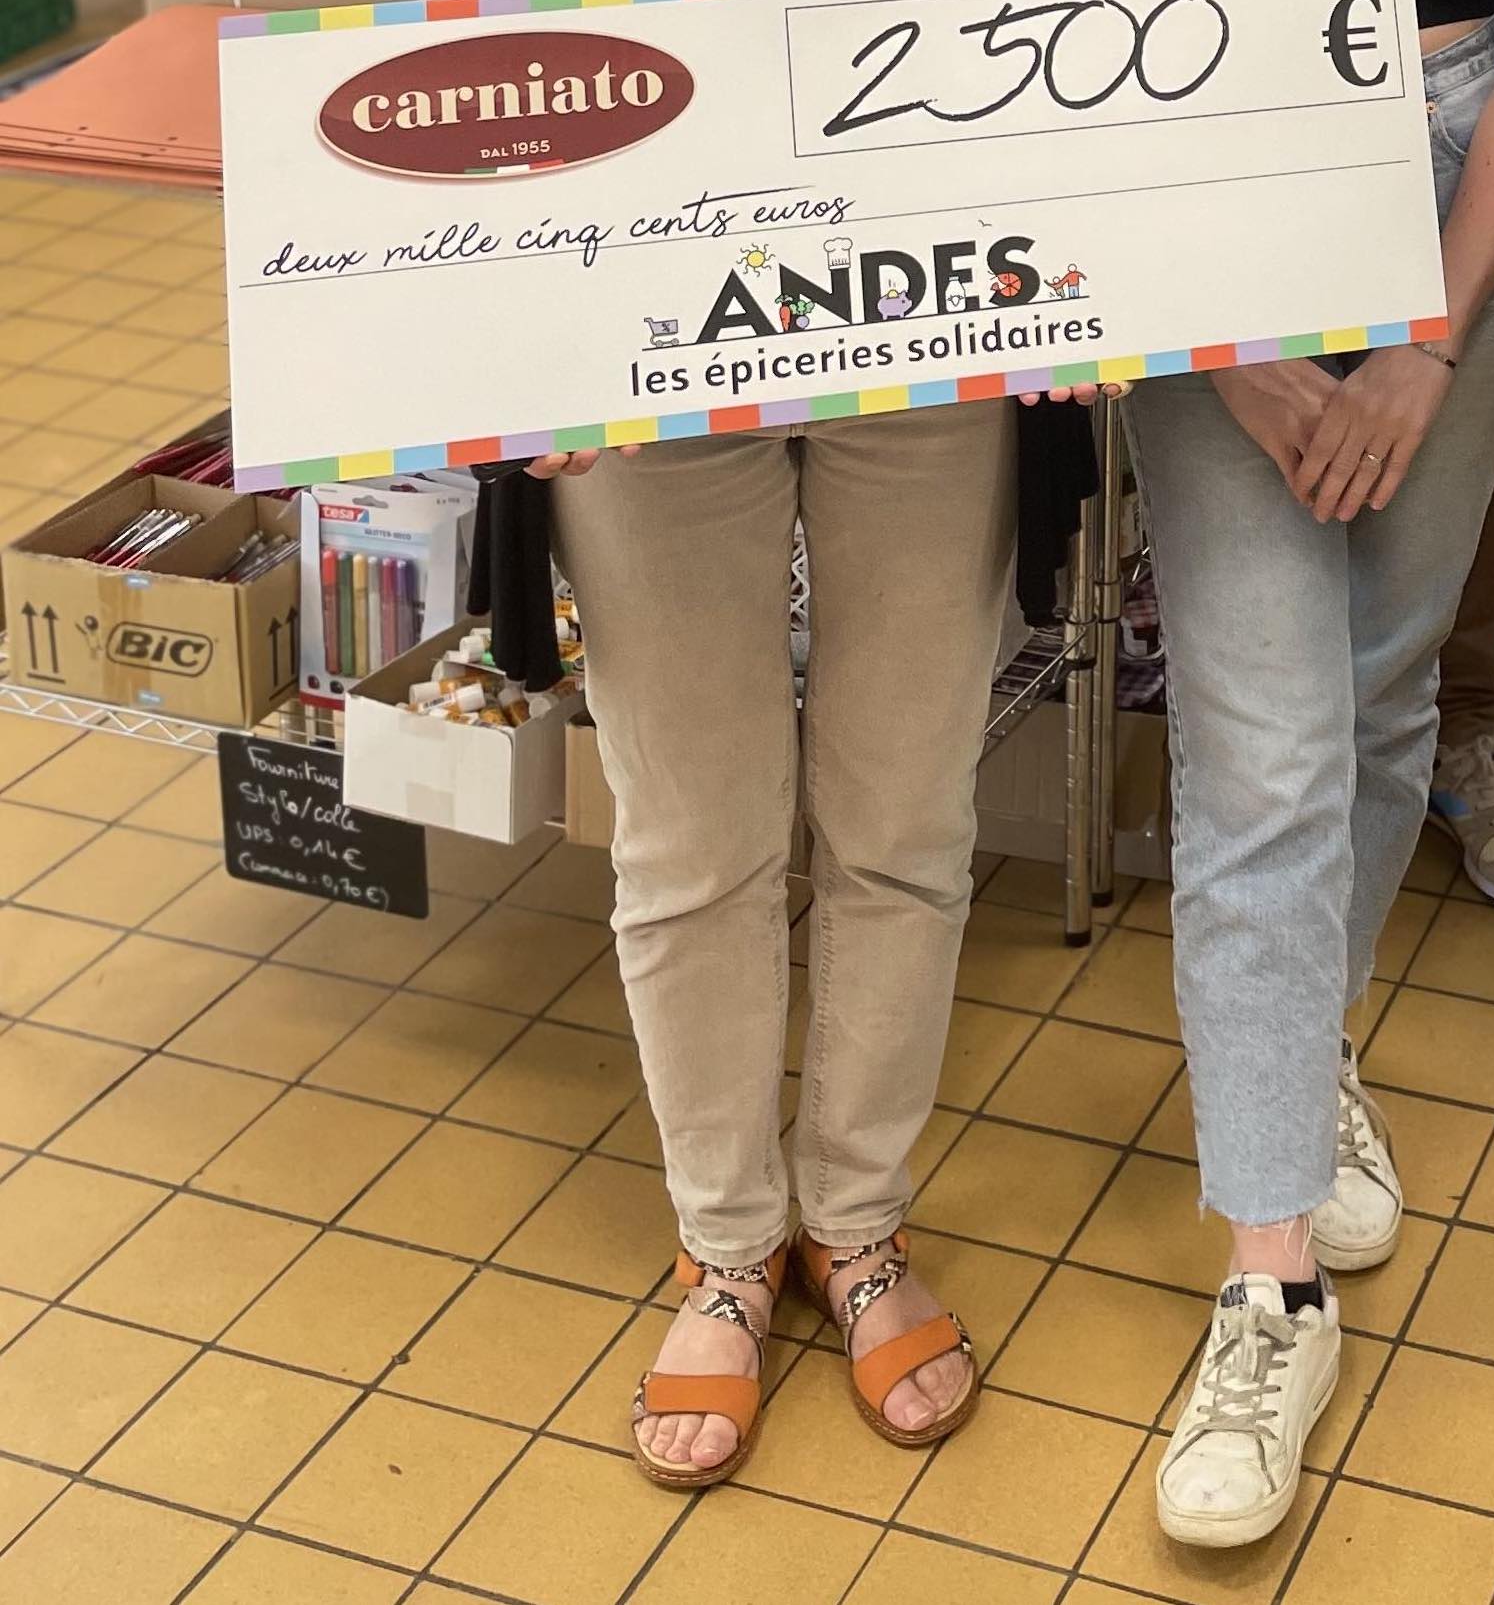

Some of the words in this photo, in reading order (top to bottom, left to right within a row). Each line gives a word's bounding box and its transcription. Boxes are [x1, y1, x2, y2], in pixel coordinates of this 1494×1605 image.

[352, 61, 665, 134] carniato
[480, 147, 509, 159] DAL
[511, 139, 551, 156] 1955
[262, 242, 367, 278] deux
[383, 223, 502, 268] mille
[516, 220, 612, 268] cinq
[753, 196, 855, 227] euros
[696, 236, 1041, 345] ANDES
[631, 362, 691, 397] les
[704, 339, 894, 395] épiceries
[908, 312, 1105, 362] solidaires
[322, 505, 355, 520] tesa
[247, 746, 340, 790] Fourniture
[236, 820, 275, 844] UPS
